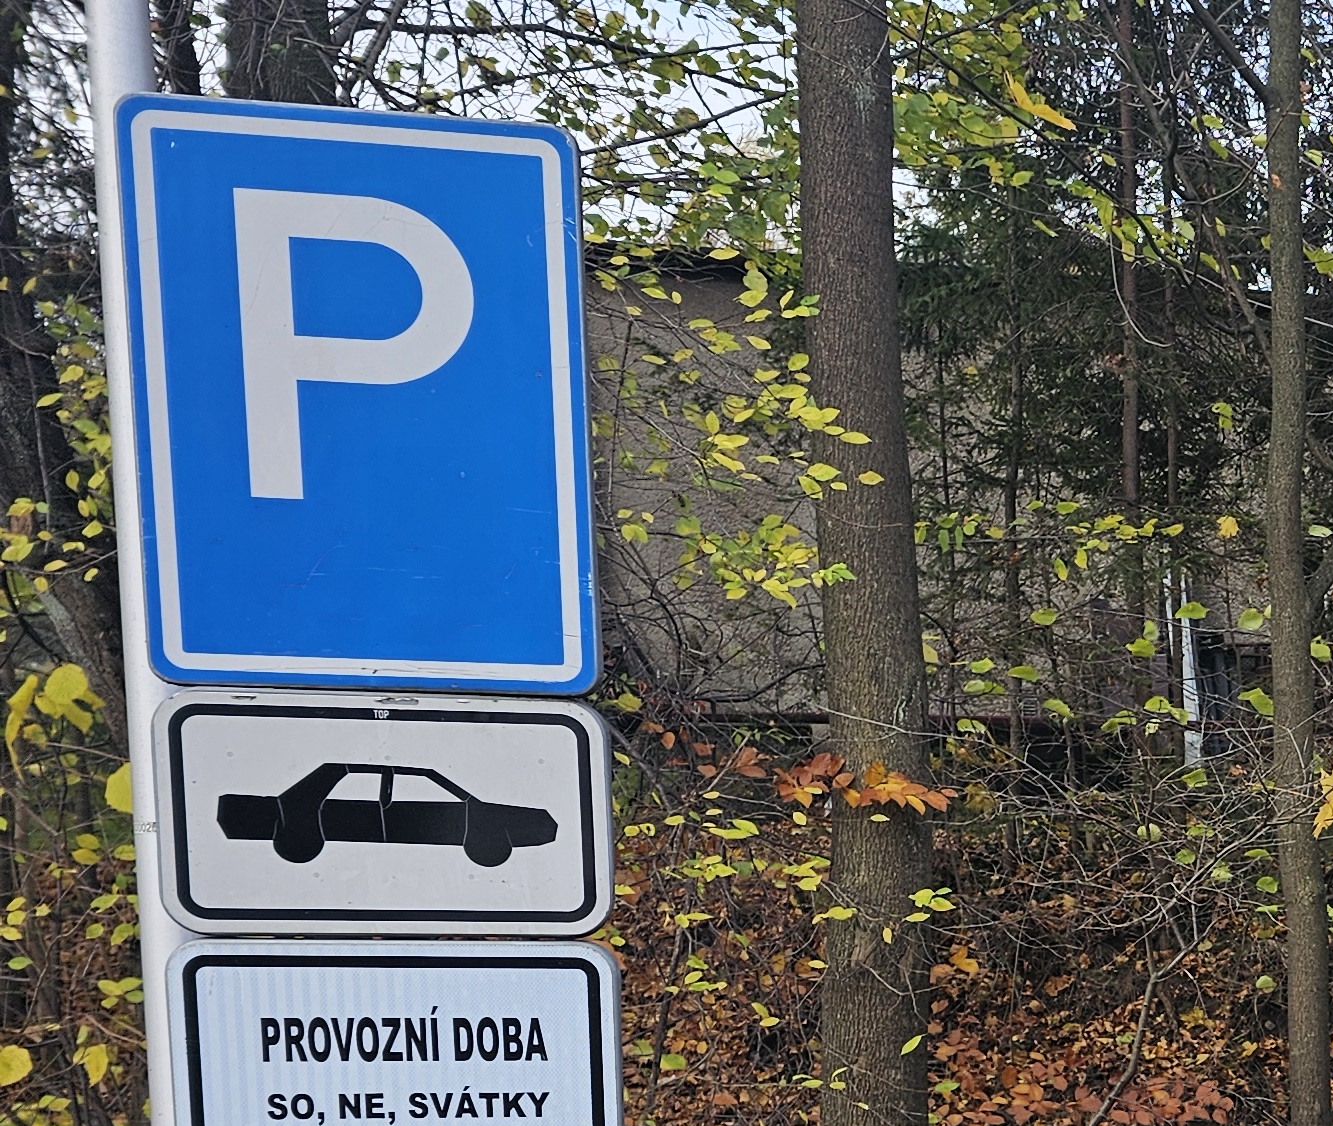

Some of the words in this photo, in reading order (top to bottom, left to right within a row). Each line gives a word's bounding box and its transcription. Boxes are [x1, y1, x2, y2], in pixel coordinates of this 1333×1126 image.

[232, 187, 476, 500] P
[372, 709, 390, 719] TOP
[259, 1005, 441, 1063] PROVOZNÍ
[451, 1016, 549, 1063] DOBA
[266, 1092, 326, 1126] SO,
[338, 1092, 397, 1126] NE,
[408, 1085, 551, 1119] SVÁTKY
